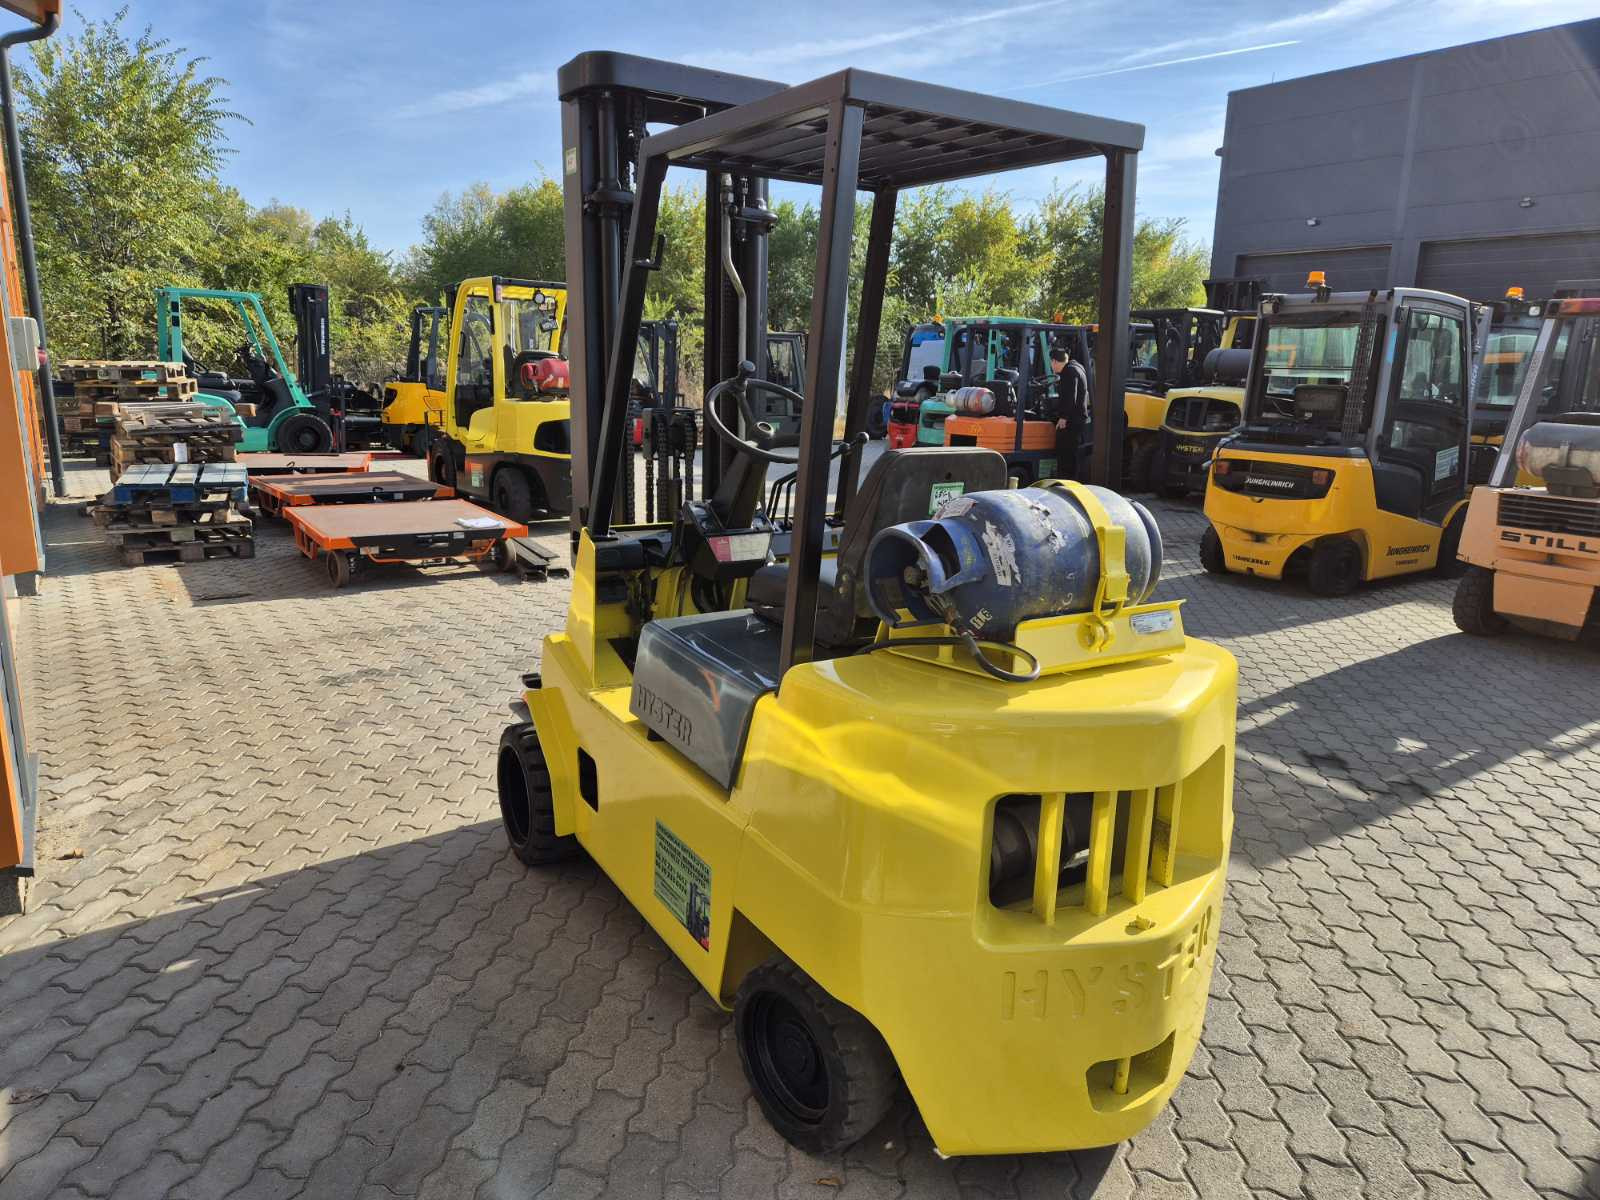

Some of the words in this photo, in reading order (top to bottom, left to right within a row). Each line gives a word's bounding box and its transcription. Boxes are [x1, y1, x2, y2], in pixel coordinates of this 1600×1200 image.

[1245, 477, 1295, 488] JUNGHEINRICH
[1501, 531, 1598, 554] STILL
[637, 684, 693, 746] HYSTER
[1001, 905, 1212, 1023] HYSTER
